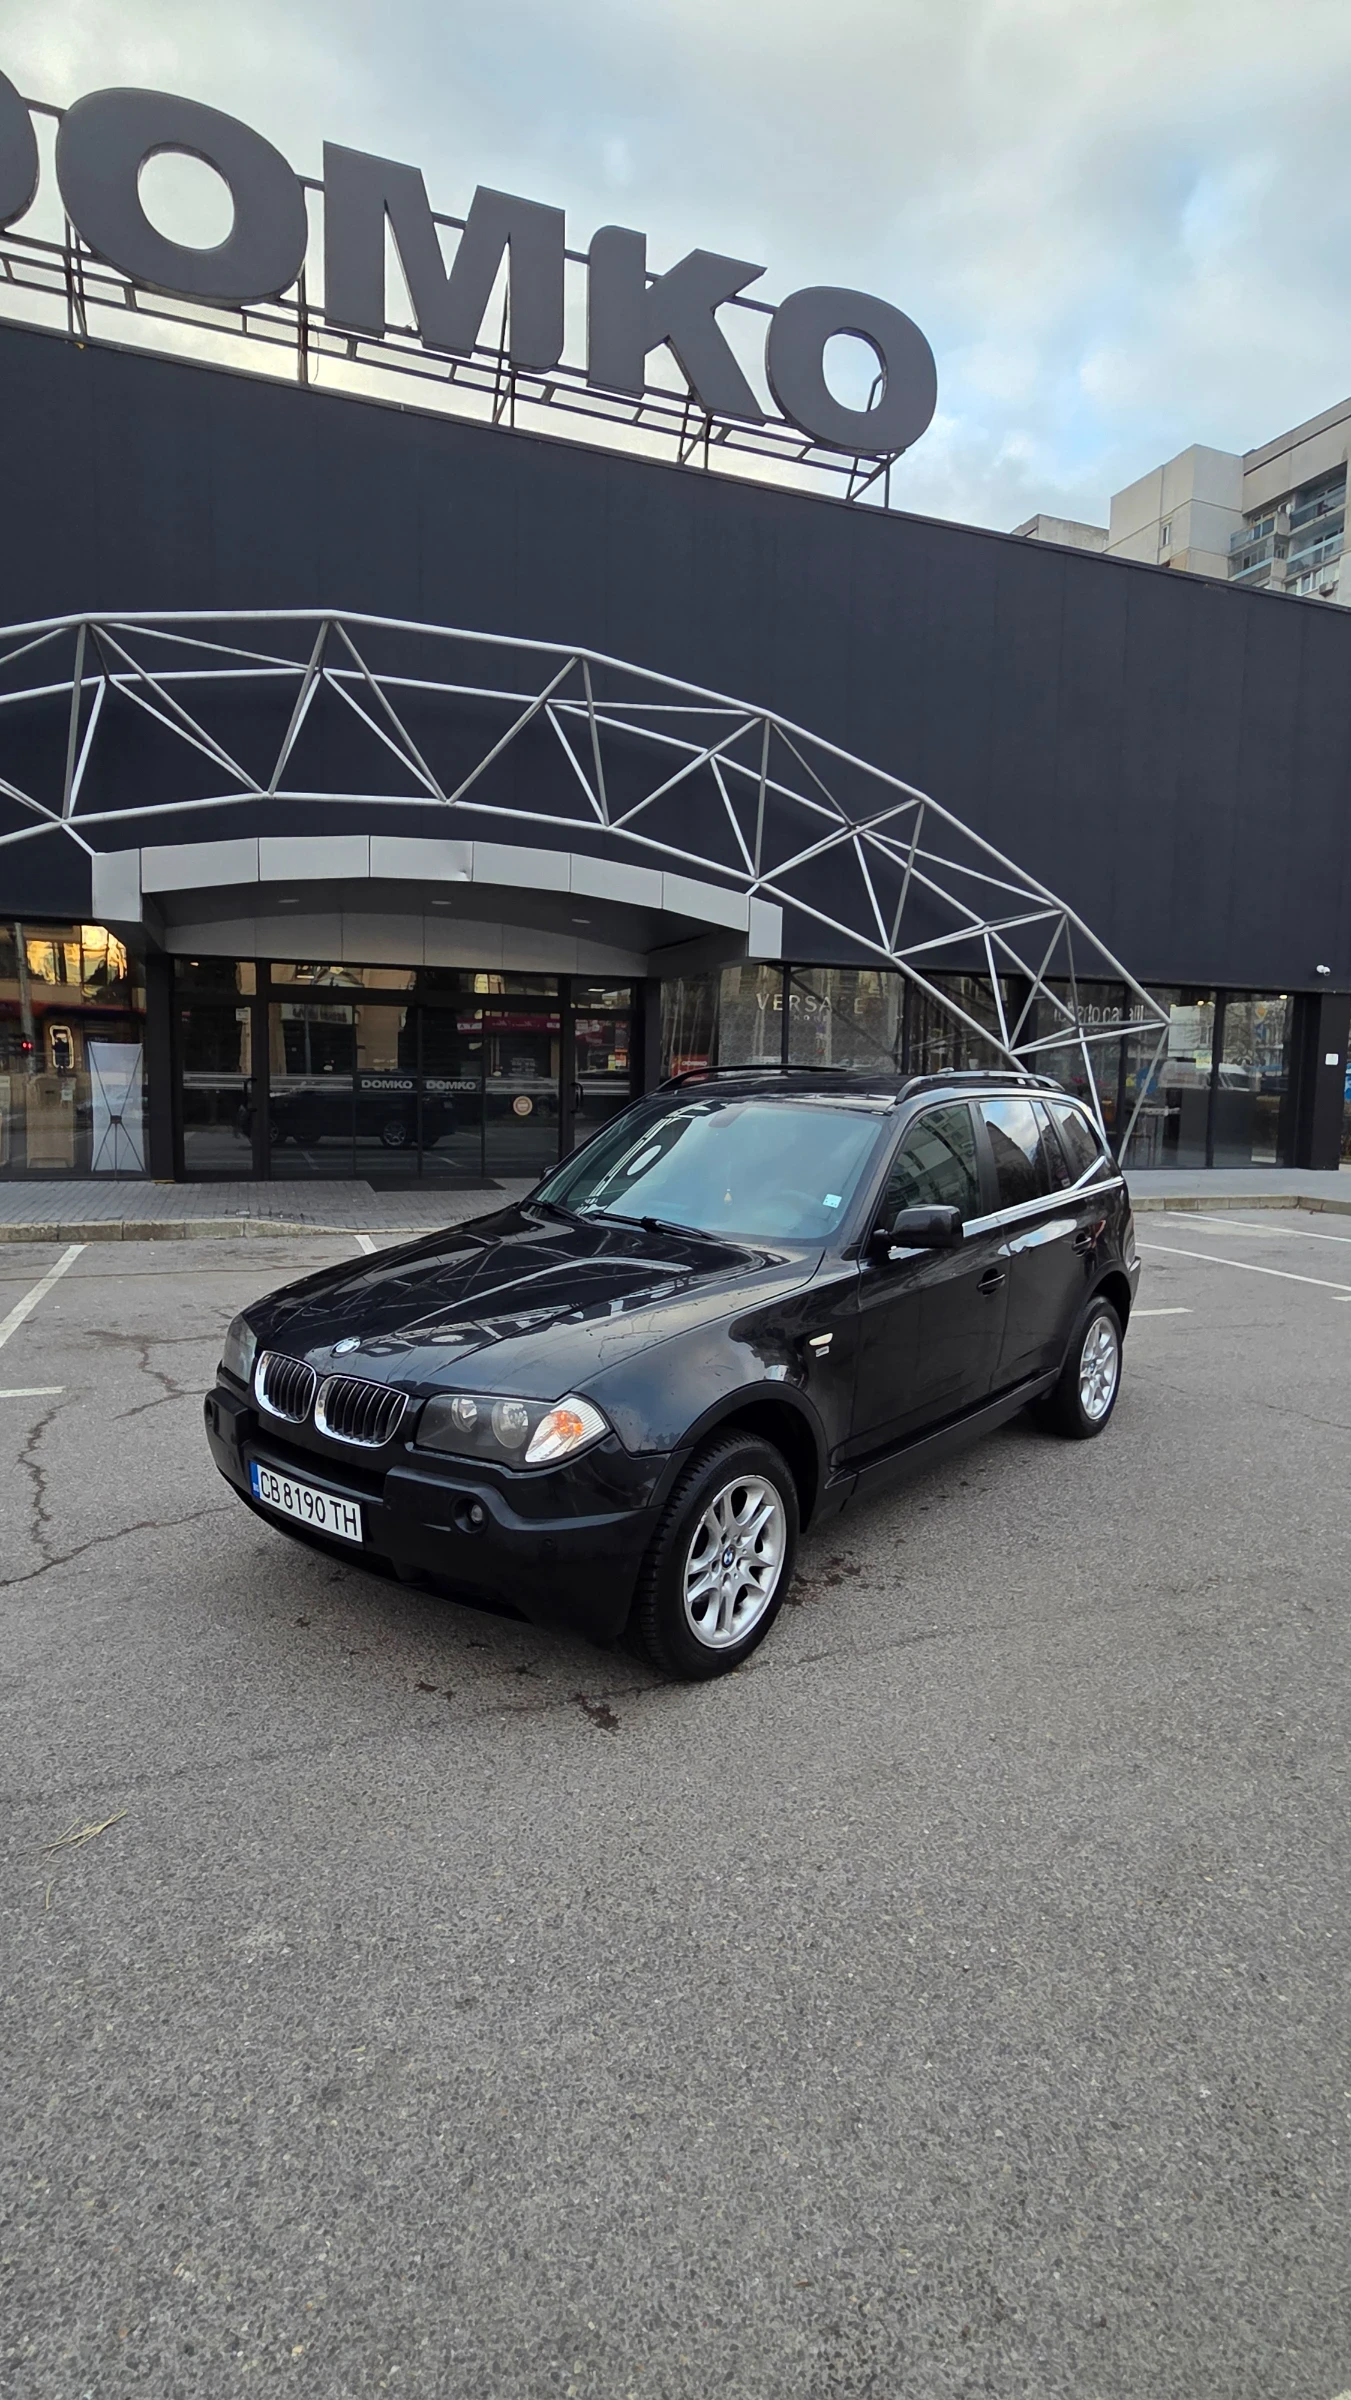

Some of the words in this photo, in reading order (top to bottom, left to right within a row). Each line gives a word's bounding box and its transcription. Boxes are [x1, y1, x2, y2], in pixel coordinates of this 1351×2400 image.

[0, 71, 937, 454] OMKO
[756, 993, 864, 1015] VERSAE
[361, 1079, 413, 1089] DOMKO
[426, 1079, 477, 1090] DOMKO
[260, 1471, 280, 1503] CB
[283, 1482, 326, 1524] 8190
[329, 1500, 358, 1536] TH
